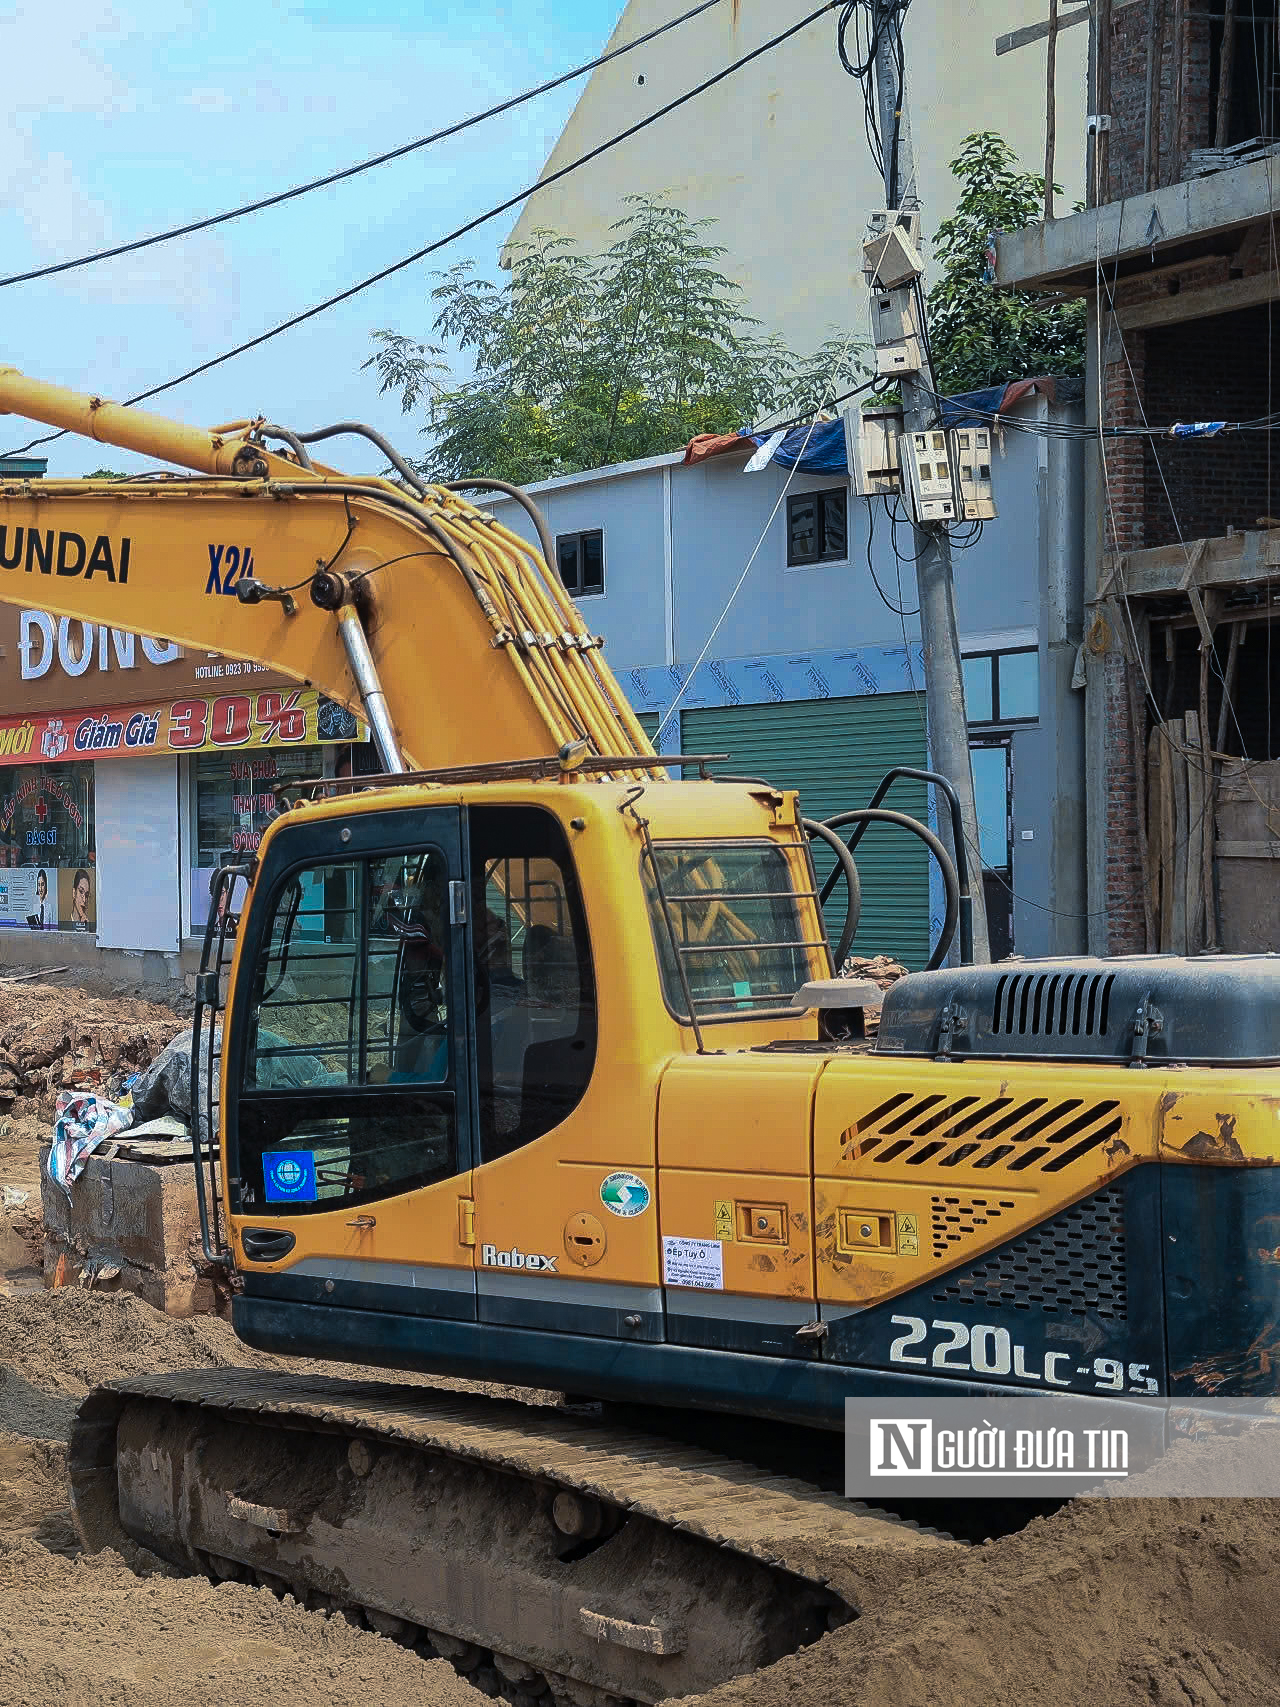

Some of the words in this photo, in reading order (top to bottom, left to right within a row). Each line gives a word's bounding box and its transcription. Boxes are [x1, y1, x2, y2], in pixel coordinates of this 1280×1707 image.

[74, 714, 123, 751] Giảm
[124, 710, 162, 748] Giá
[168, 689, 307, 750] 30%
[481, 1243, 559, 1273] Robex
[684, 1249, 698, 1259] Tuy
